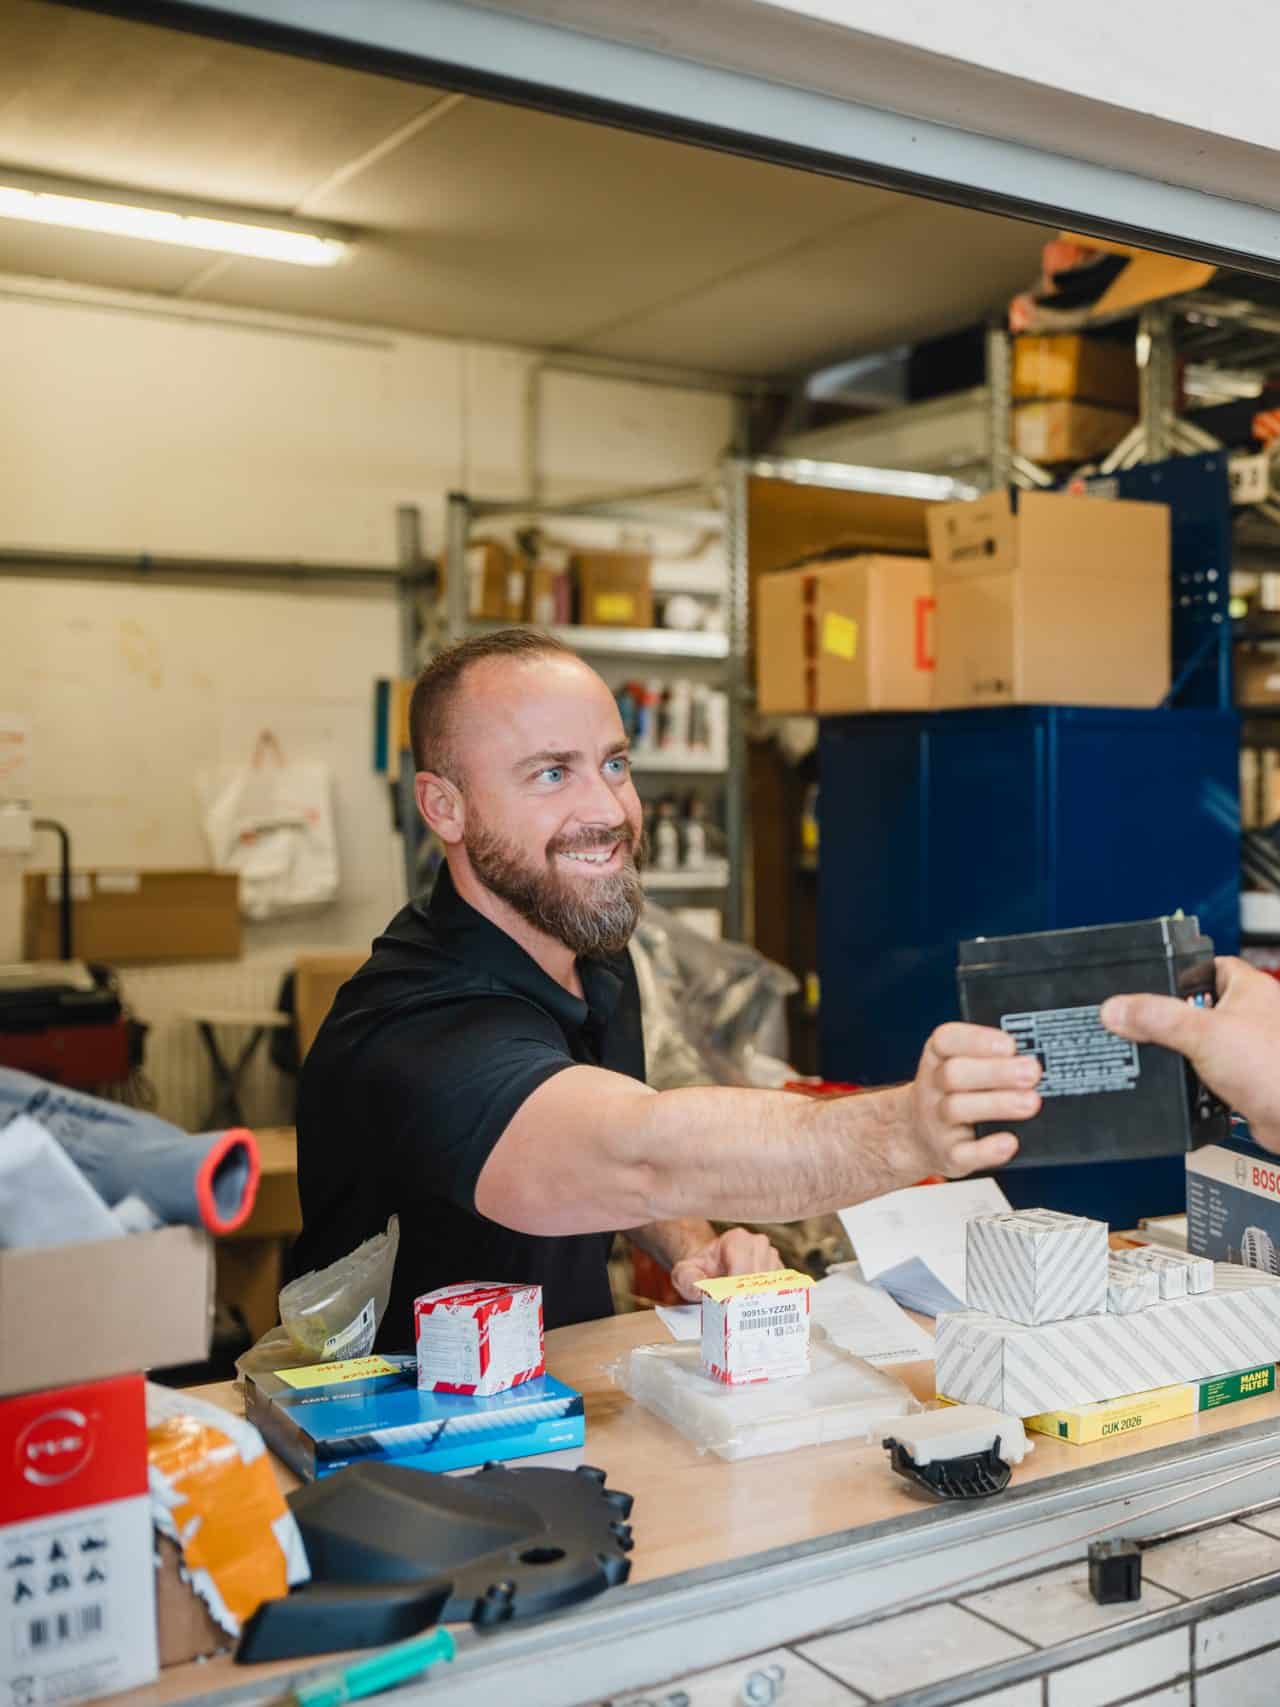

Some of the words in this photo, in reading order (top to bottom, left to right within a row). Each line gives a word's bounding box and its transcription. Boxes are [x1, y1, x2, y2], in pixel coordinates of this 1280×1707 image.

[1240, 1370, 1269, 1384] MANN
[1239, 1379, 1269, 1393] FILTER
[1101, 1420, 1121, 1436] CUK
[1120, 1415, 1143, 1432] 2026
